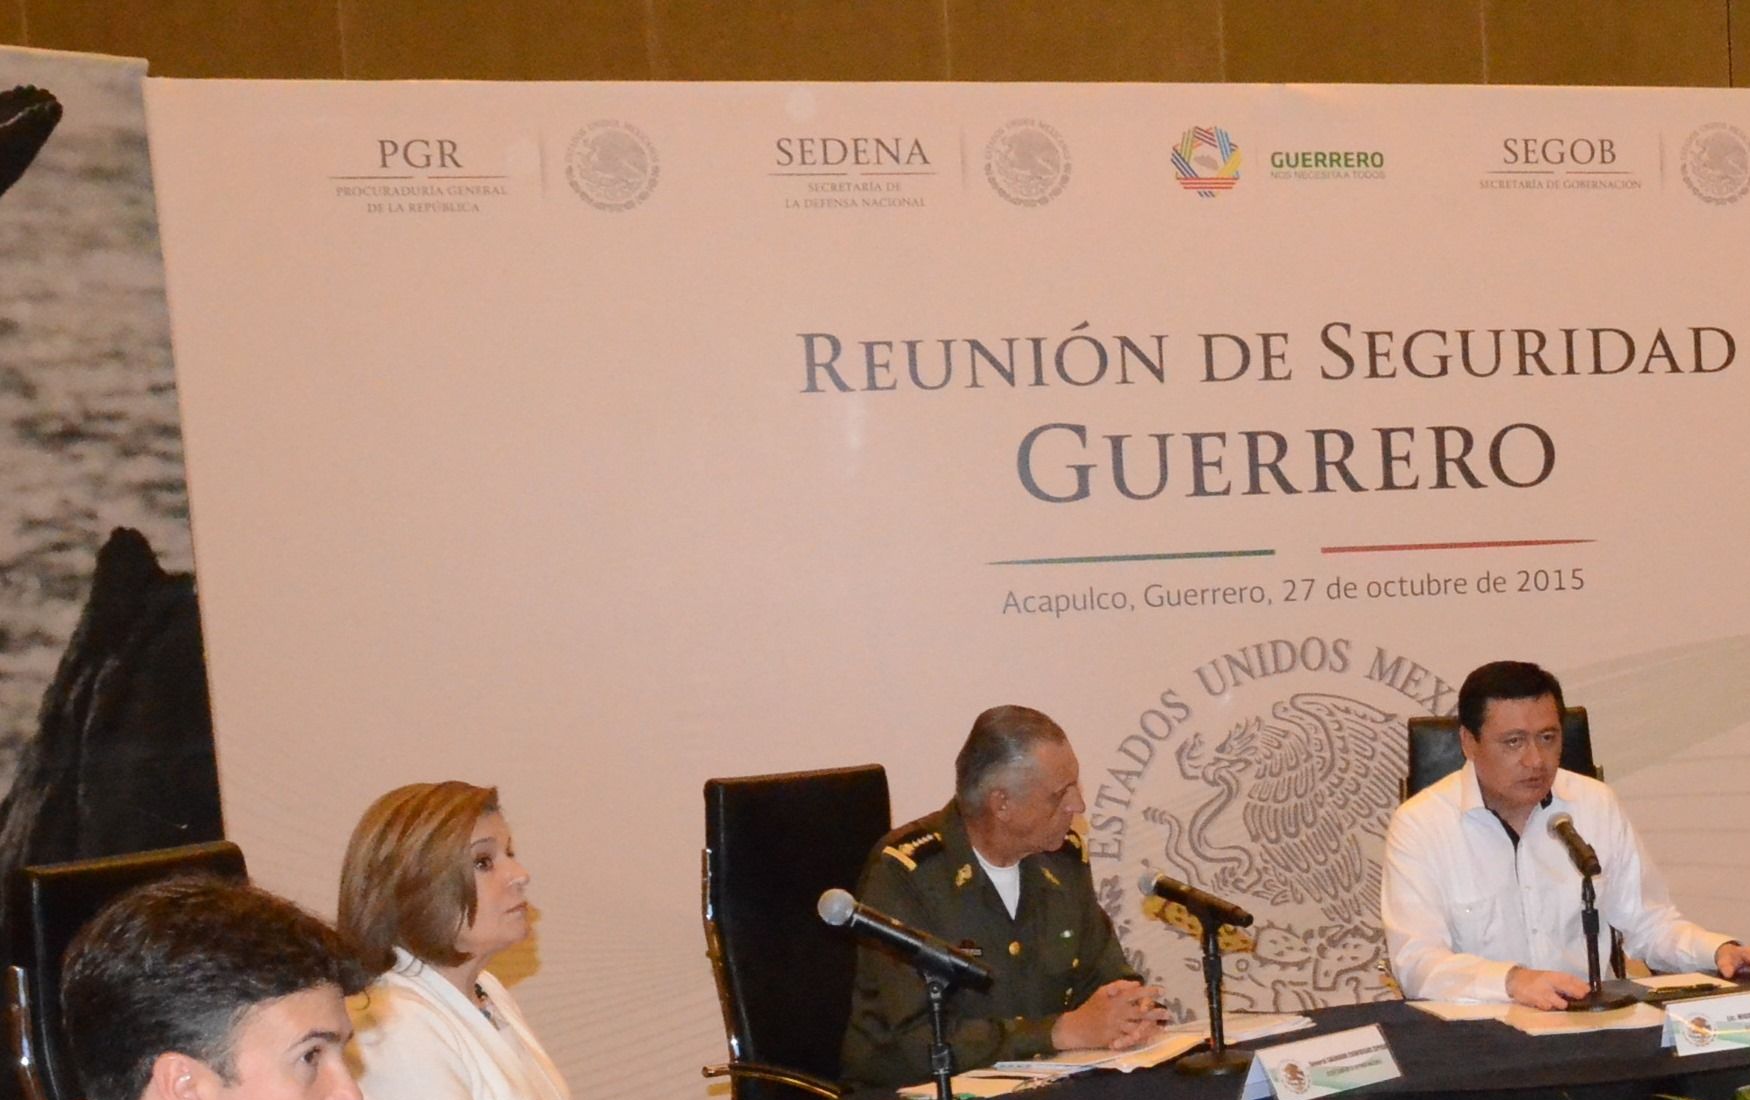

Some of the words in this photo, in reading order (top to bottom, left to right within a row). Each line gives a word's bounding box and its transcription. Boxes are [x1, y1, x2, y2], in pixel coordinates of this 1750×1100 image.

[377, 138, 463, 169] PGR
[775, 137, 931, 167] SEDENA
[1270, 151, 1384, 169] GUERRERO
[1503, 137, 1617, 165] SEGOB
[796, 320, 1169, 395] REUNIÓN
[1200, 331, 1292, 384] DE
[1319, 321, 1737, 385] SEGURIDAD
[1015, 421, 1558, 505] GUERRERO
[1001, 579, 1134, 617] Acapulco,
[1143, 581, 1271, 612] Guerrero,
[1281, 577, 1316, 604] 27
[1325, 576, 1359, 601] de
[1366, 572, 1468, 600] octubre
[1475, 570, 1508, 596] de
[1516, 568, 1586, 595] 2015
[1088, 688, 1191, 862] ESTADOS
[1193, 636, 1352, 697] UNIDOS
